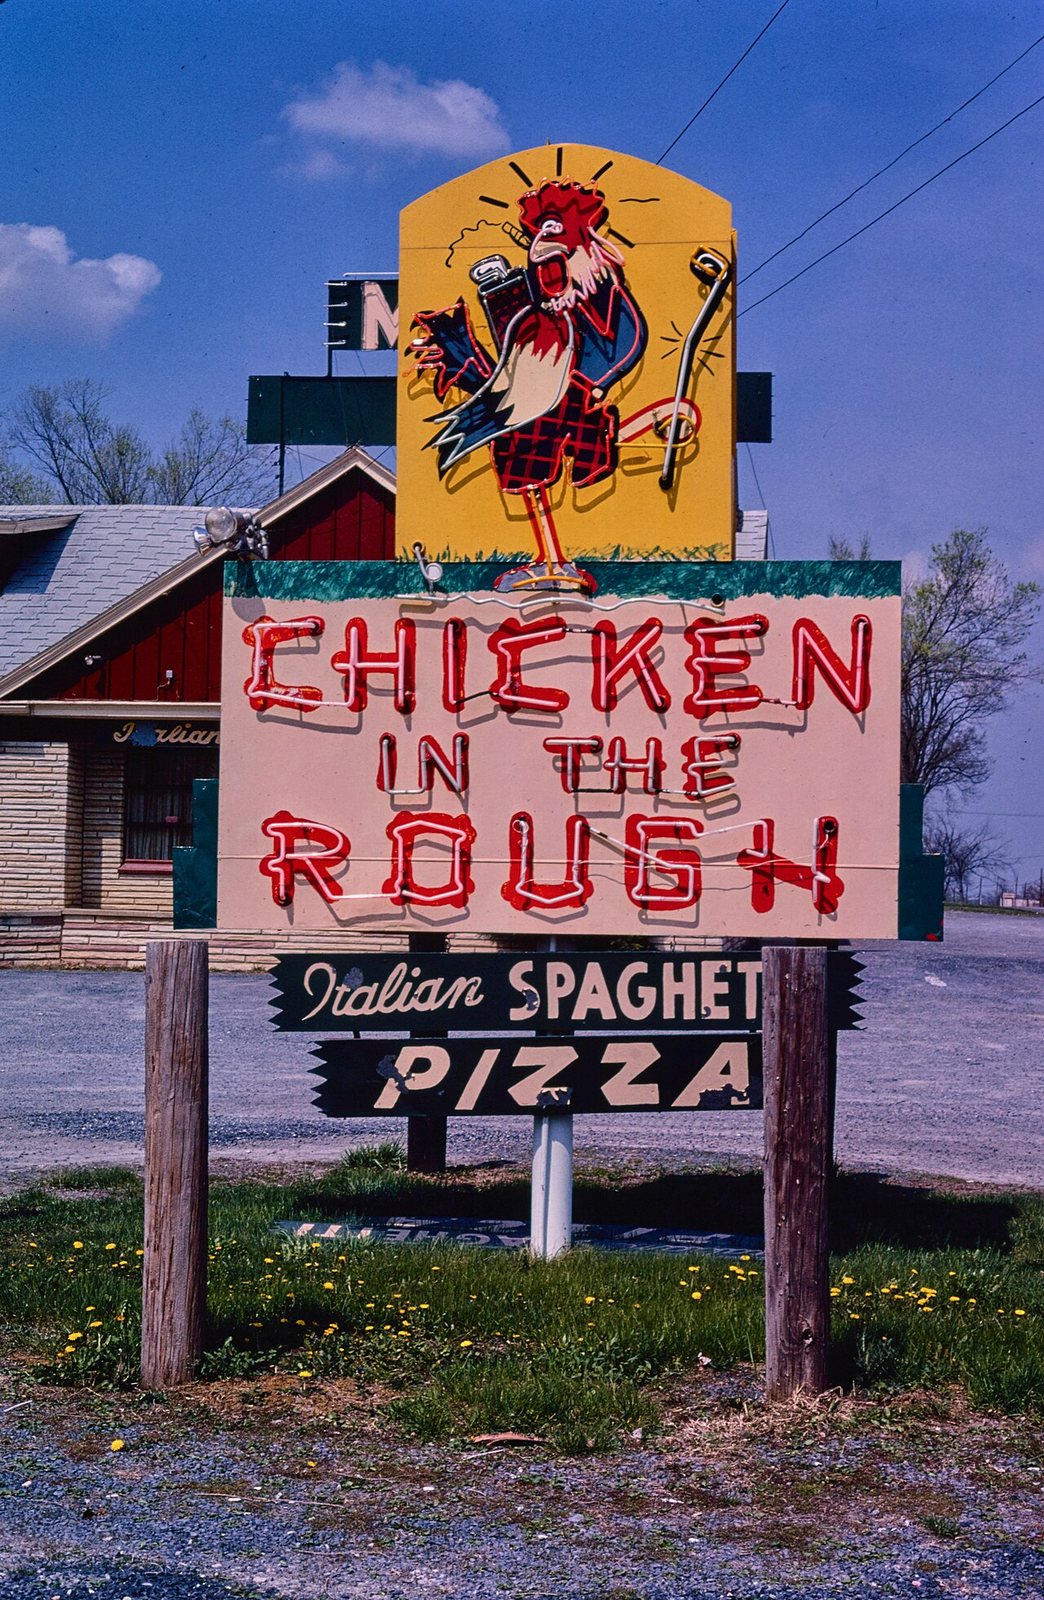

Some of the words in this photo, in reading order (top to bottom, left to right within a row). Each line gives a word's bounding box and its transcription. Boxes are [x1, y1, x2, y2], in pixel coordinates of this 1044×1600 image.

[242, 614, 873, 719] CHICKEN
[376, 732, 470, 795] IN
[543, 732, 741, 800] THE
[259, 810, 845, 914] ROUGH
[301, 962, 485, 1021] Italian
[373, 1041, 750, 1110] PIZZA
